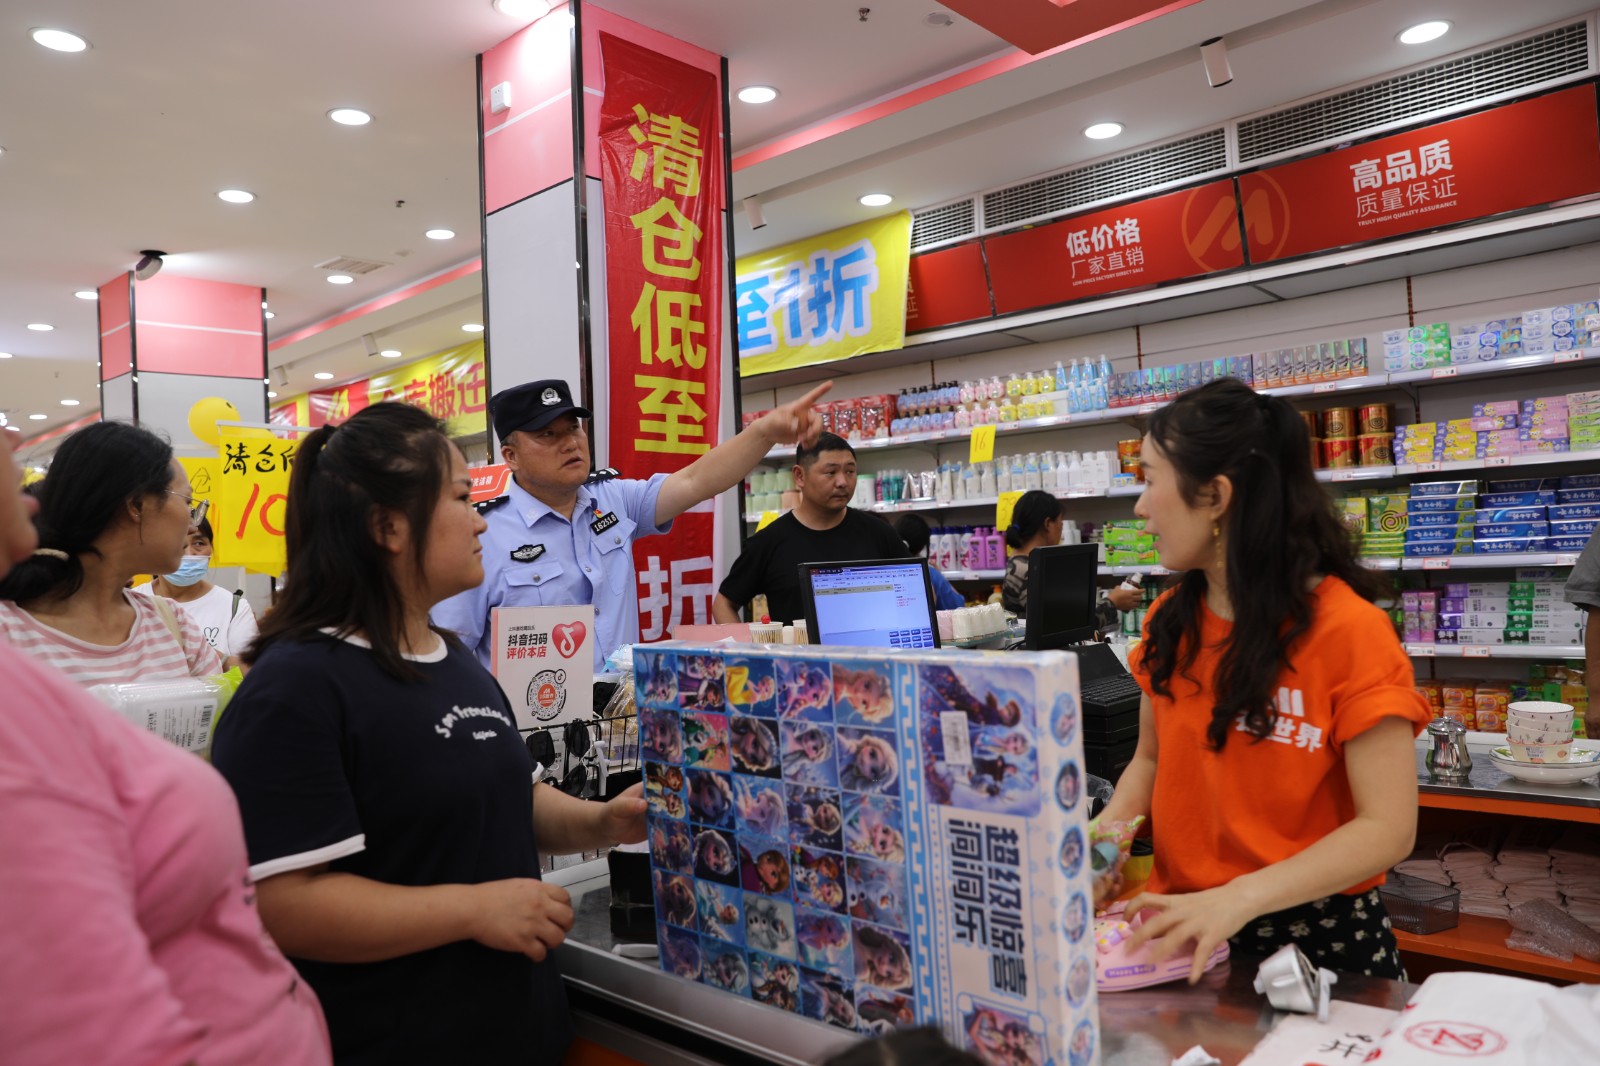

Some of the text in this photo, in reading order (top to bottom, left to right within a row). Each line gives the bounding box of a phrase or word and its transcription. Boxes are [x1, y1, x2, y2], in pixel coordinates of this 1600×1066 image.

[1350, 139, 1453, 192] 高品质
[1357, 174, 1458, 218] 质量保证
[1358, 200, 1457, 227] TRULY HIGH QUALITY ASSURANCE
[1066, 218, 1140, 258] 低价格
[1071, 246, 1144, 279] 厂家直销
[507, 645, 547, 660] 评价本店
[508, 633, 548, 647] 抖音扫码
[948, 818, 987, 946] 洞洞乐
[986, 824, 1027, 998] 超级惊喜
